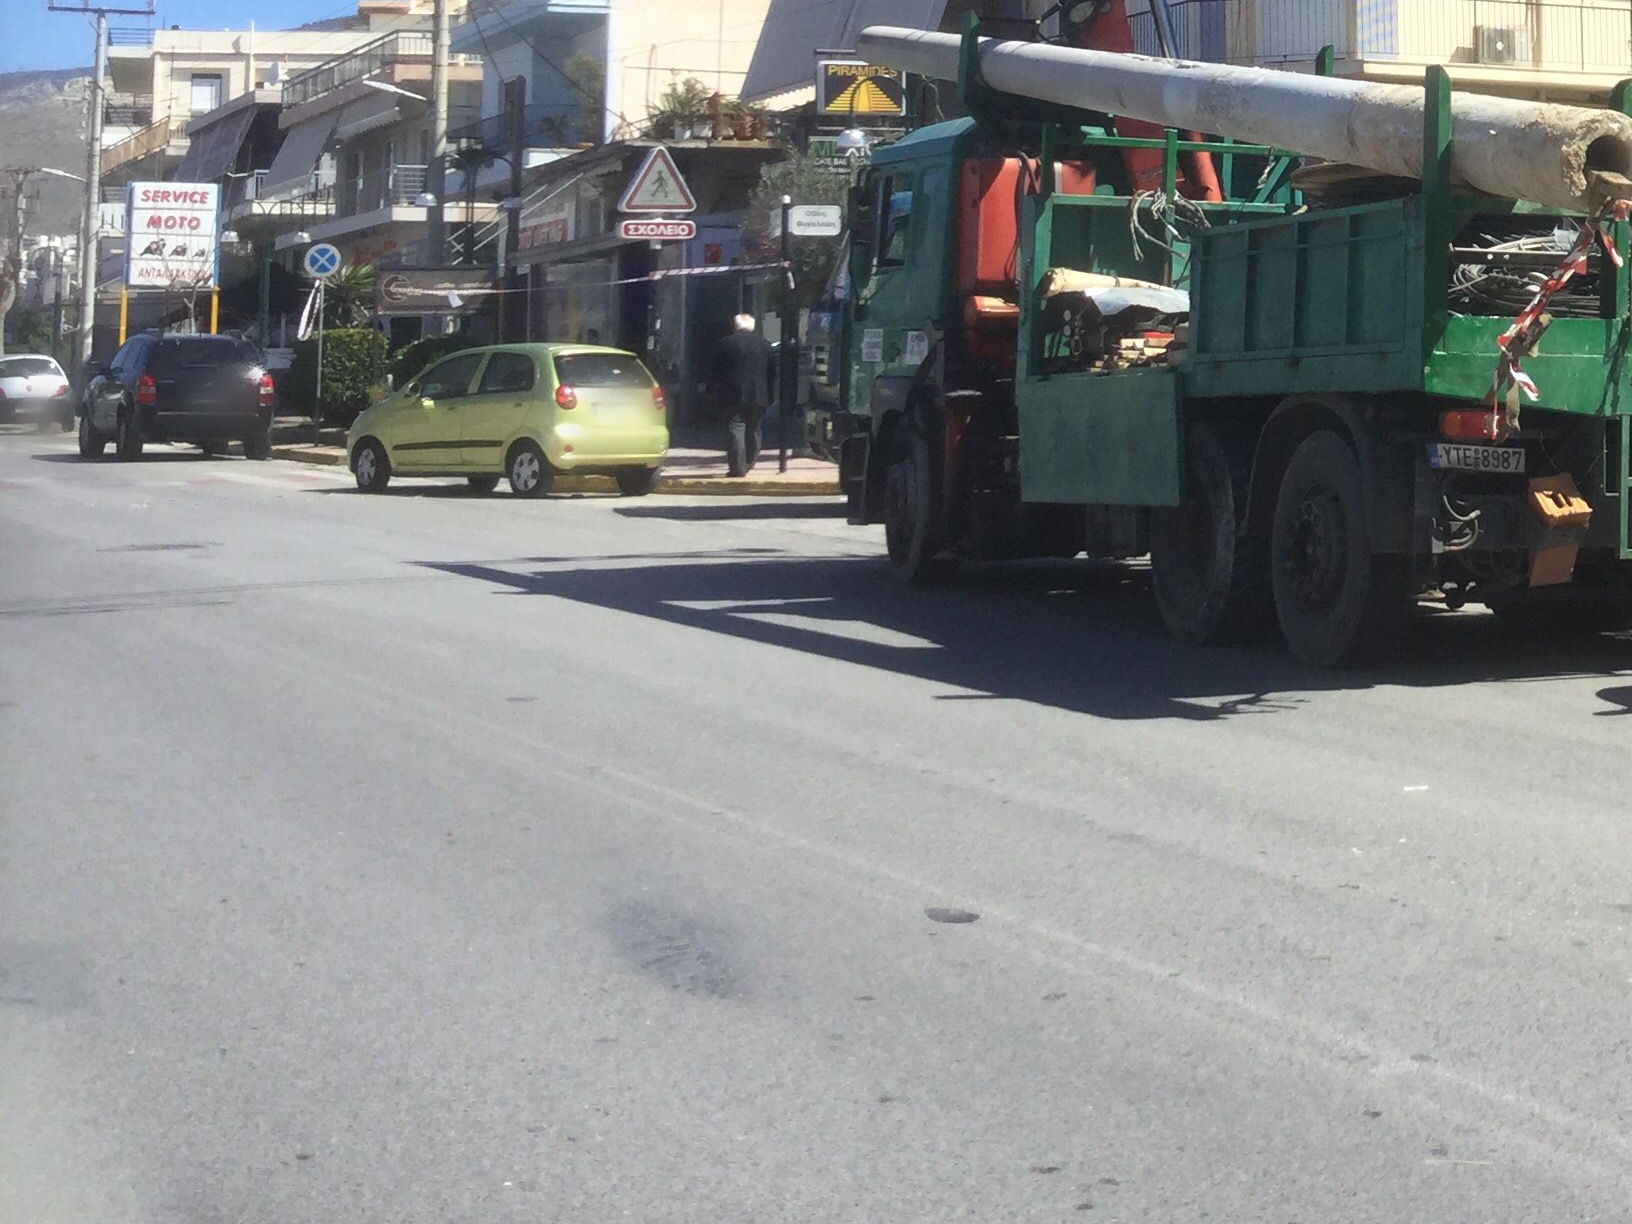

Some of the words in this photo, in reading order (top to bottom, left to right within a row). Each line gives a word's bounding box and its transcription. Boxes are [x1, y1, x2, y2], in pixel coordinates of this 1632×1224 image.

[140, 189, 210, 205] SERVICE
[146, 215, 201, 231] MOTO
[627, 224, 689, 236] ΣΧΟΛΕΙΟ
